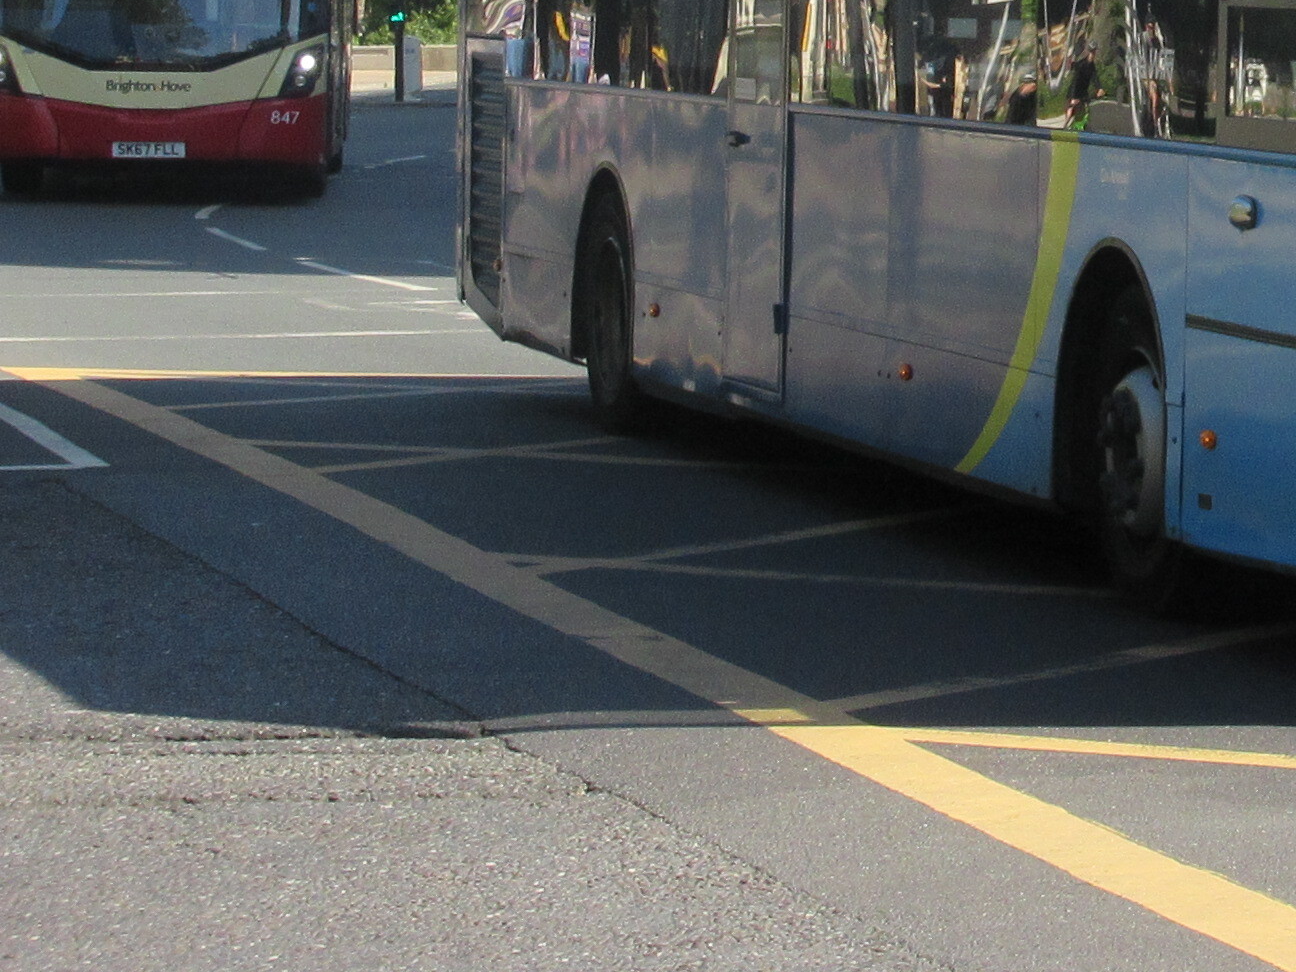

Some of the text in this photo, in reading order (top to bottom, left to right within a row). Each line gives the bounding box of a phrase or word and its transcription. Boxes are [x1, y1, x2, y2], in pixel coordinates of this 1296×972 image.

[270, 110, 301, 125] 847
[117, 143, 179, 156] SK67 FLL
